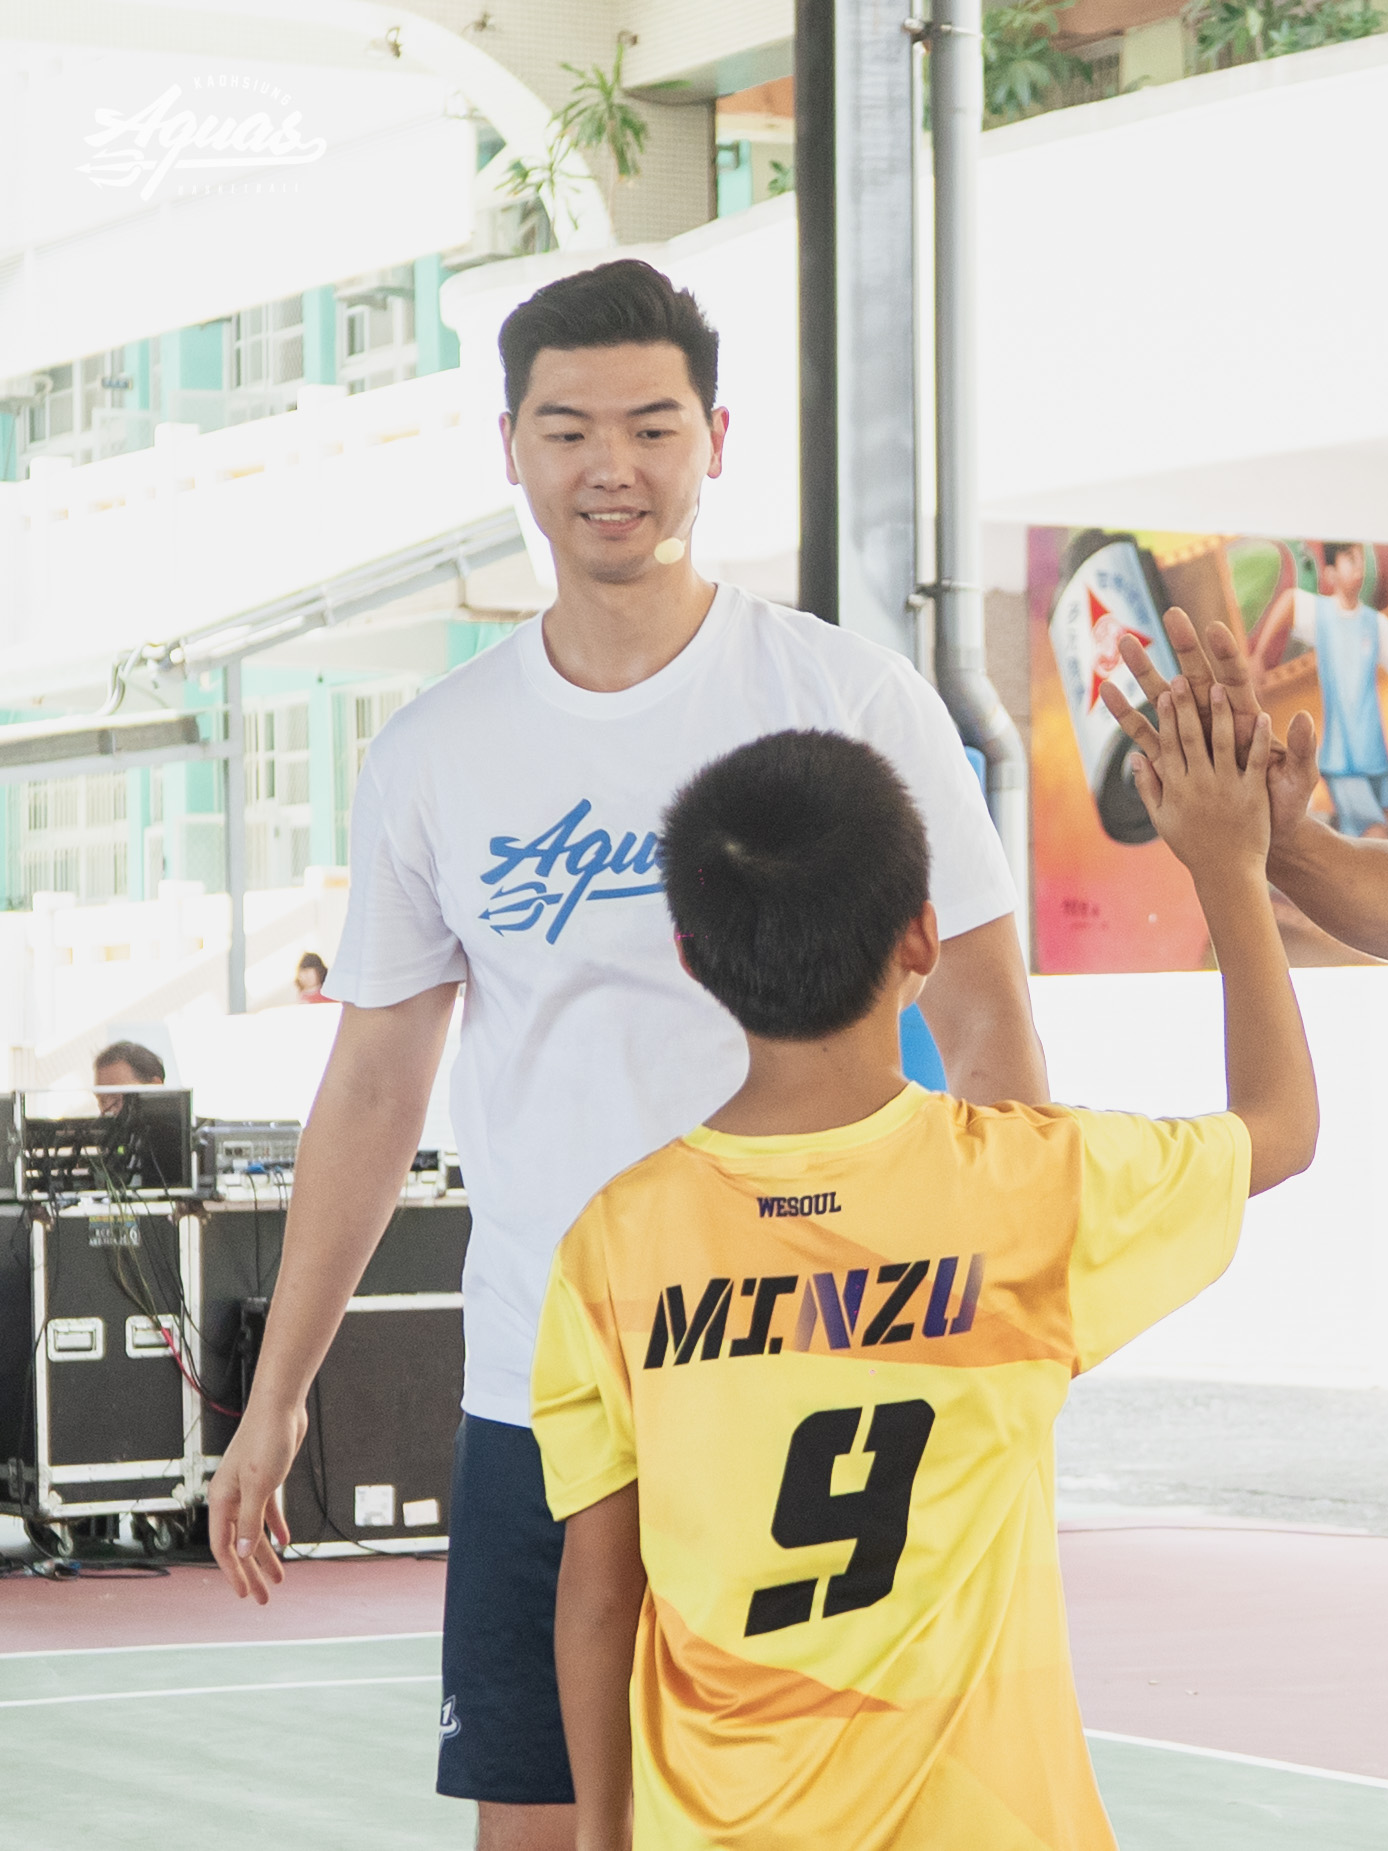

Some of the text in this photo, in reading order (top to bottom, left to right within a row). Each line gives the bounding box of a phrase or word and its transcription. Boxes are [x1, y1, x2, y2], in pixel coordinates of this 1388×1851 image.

[479, 798, 664, 945] Aqu
[756, 1191, 842, 1218] WESOUL
[642, 1252, 985, 1370] MINZU
[743, 1398, 936, 1638] 9
